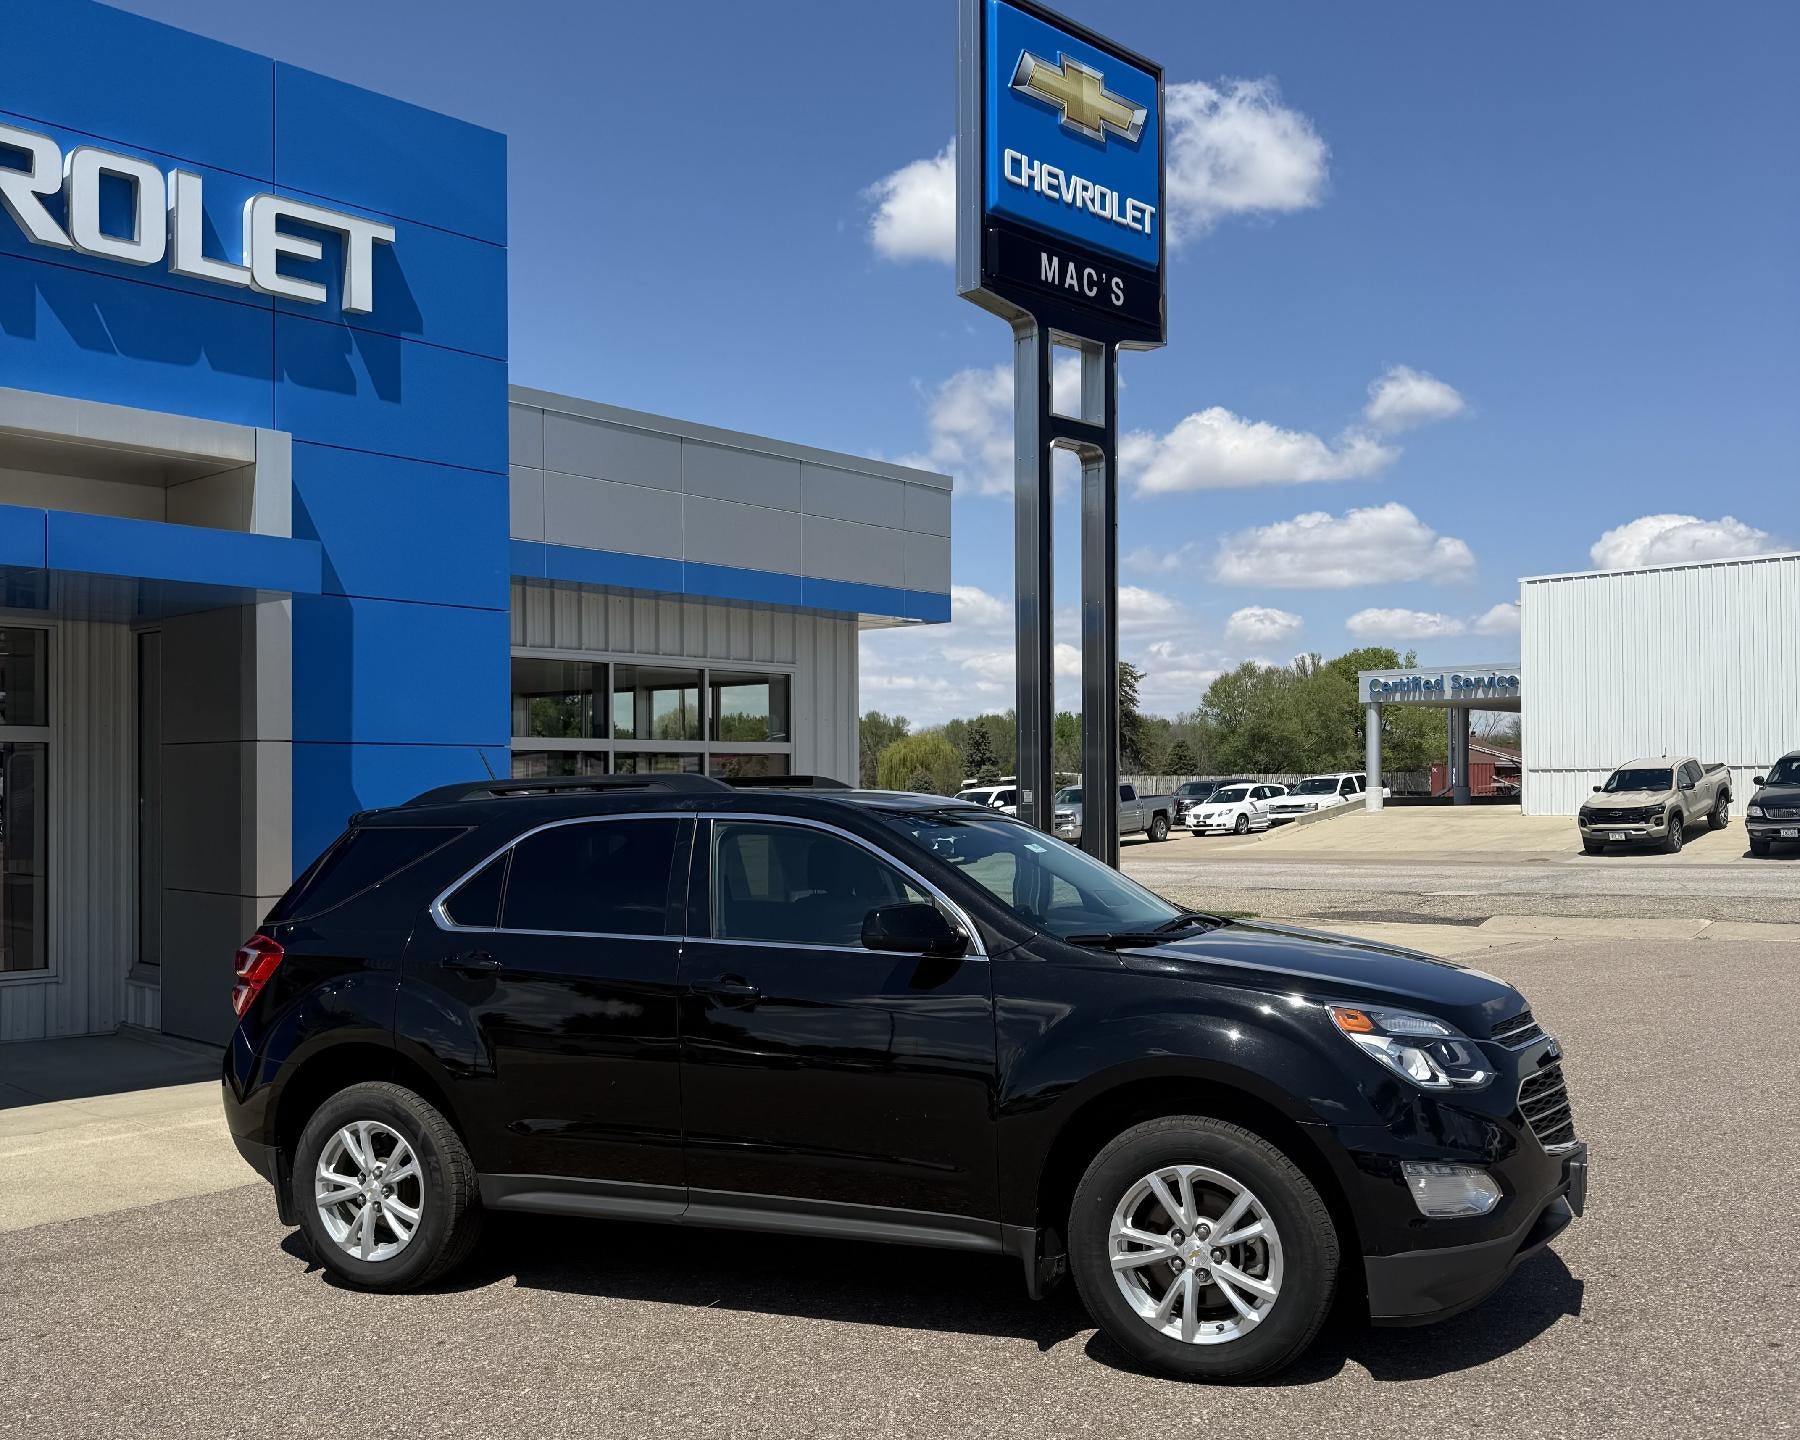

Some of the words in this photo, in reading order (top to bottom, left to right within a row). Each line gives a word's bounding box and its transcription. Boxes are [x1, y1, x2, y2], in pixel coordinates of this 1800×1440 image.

[1005, 149, 1155, 234] CHEVROLET
[1041, 252, 1125, 306] MAC'S
[1369, 675, 1444, 693] Certified
[1451, 673, 1519, 690] Service
